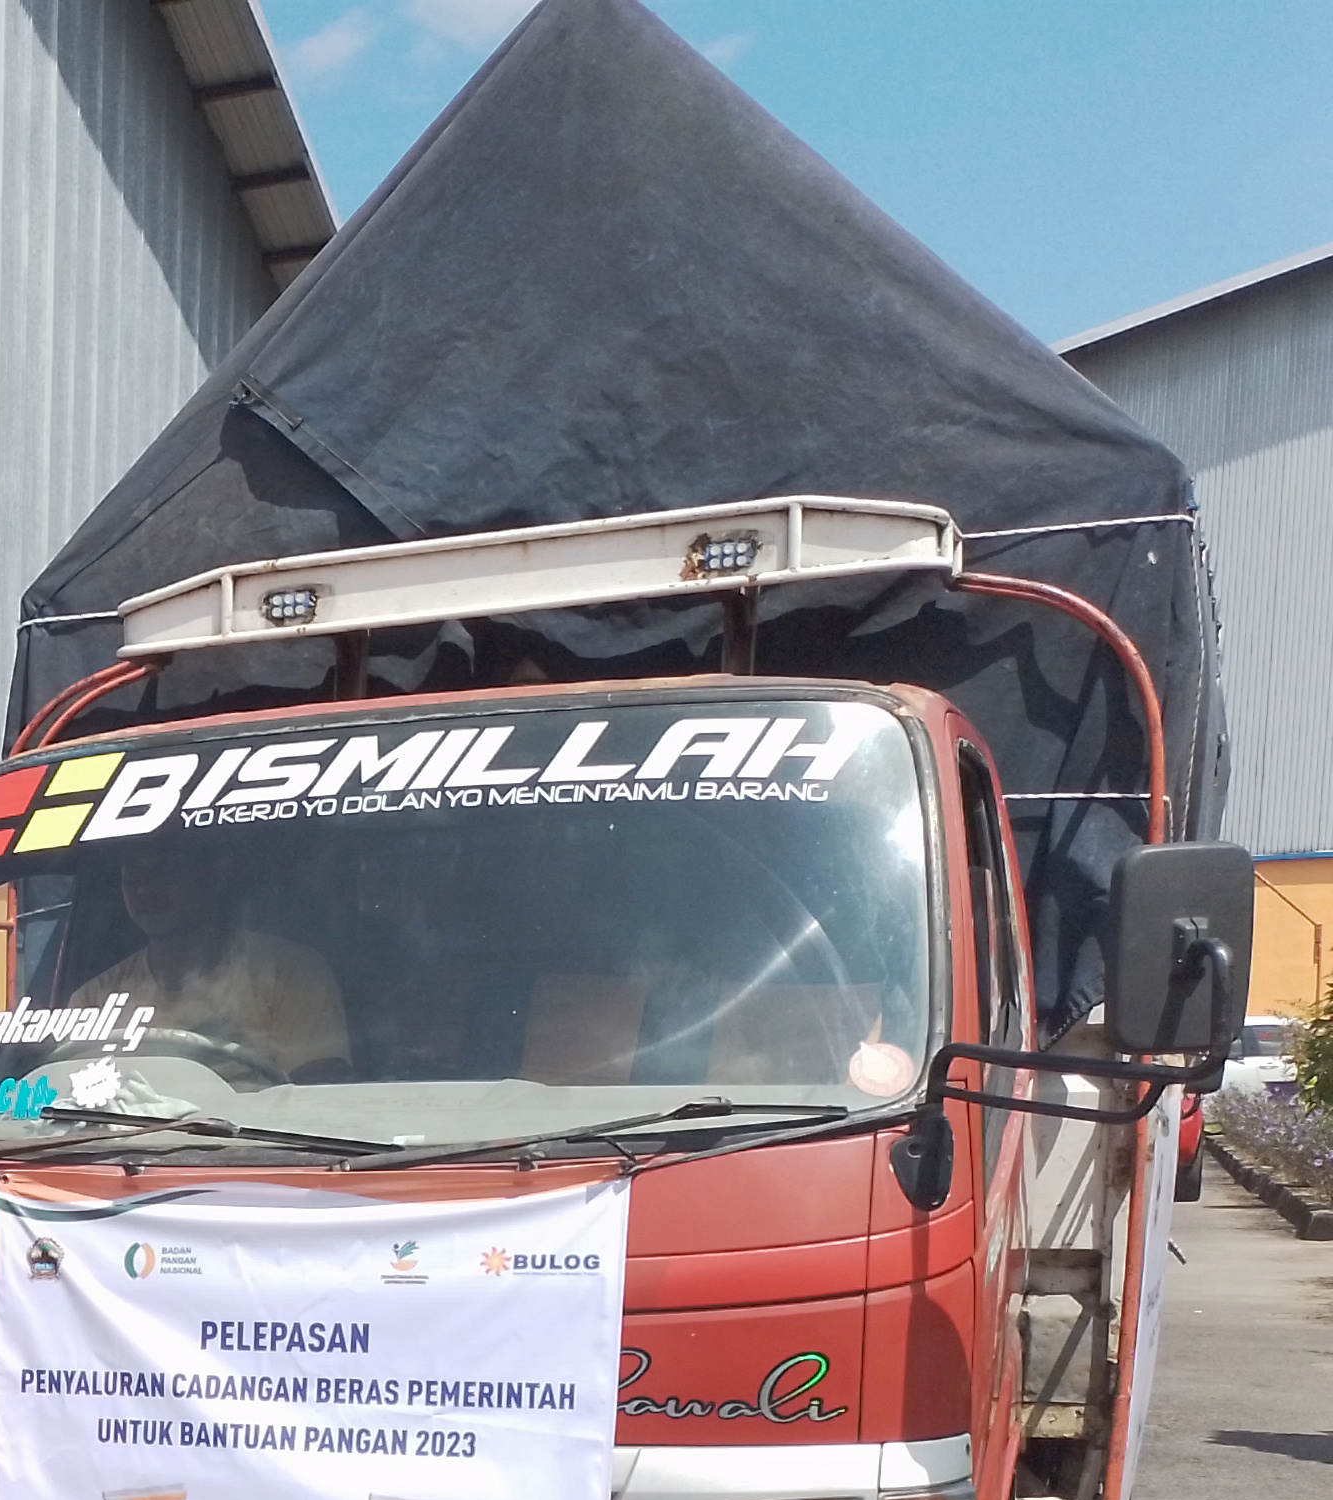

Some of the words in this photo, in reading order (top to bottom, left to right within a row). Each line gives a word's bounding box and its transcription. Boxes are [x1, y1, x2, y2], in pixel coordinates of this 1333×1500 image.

[79, 717, 866, 841] BISMILLAH
[181, 808, 214, 828] YO
[217, 801, 297, 825] KERJO
[301, 799, 337, 818] YO
[342, 789, 441, 812] DOLAN
[445, 789, 482, 808] YO
[488, 782, 689, 806] MENCINTAIMU
[694, 781, 829, 802] BARANG
[513, 1254, 600, 1270] BULOG
[200, 1320, 370, 1353] PELEPASAN
[20, 1369, 166, 1398] PENYALURAN
[172, 1373, 308, 1402] CADANGAN
[315, 1377, 400, 1405] BERAS
[406, 1380, 576, 1410] PEMERINTAH
[97, 1418, 174, 1446] UNTUK
[180, 1421, 297, 1451] BANTUAN
[303, 1426, 408, 1455] PANGAN
[415, 1430, 477, 1458] 2023
